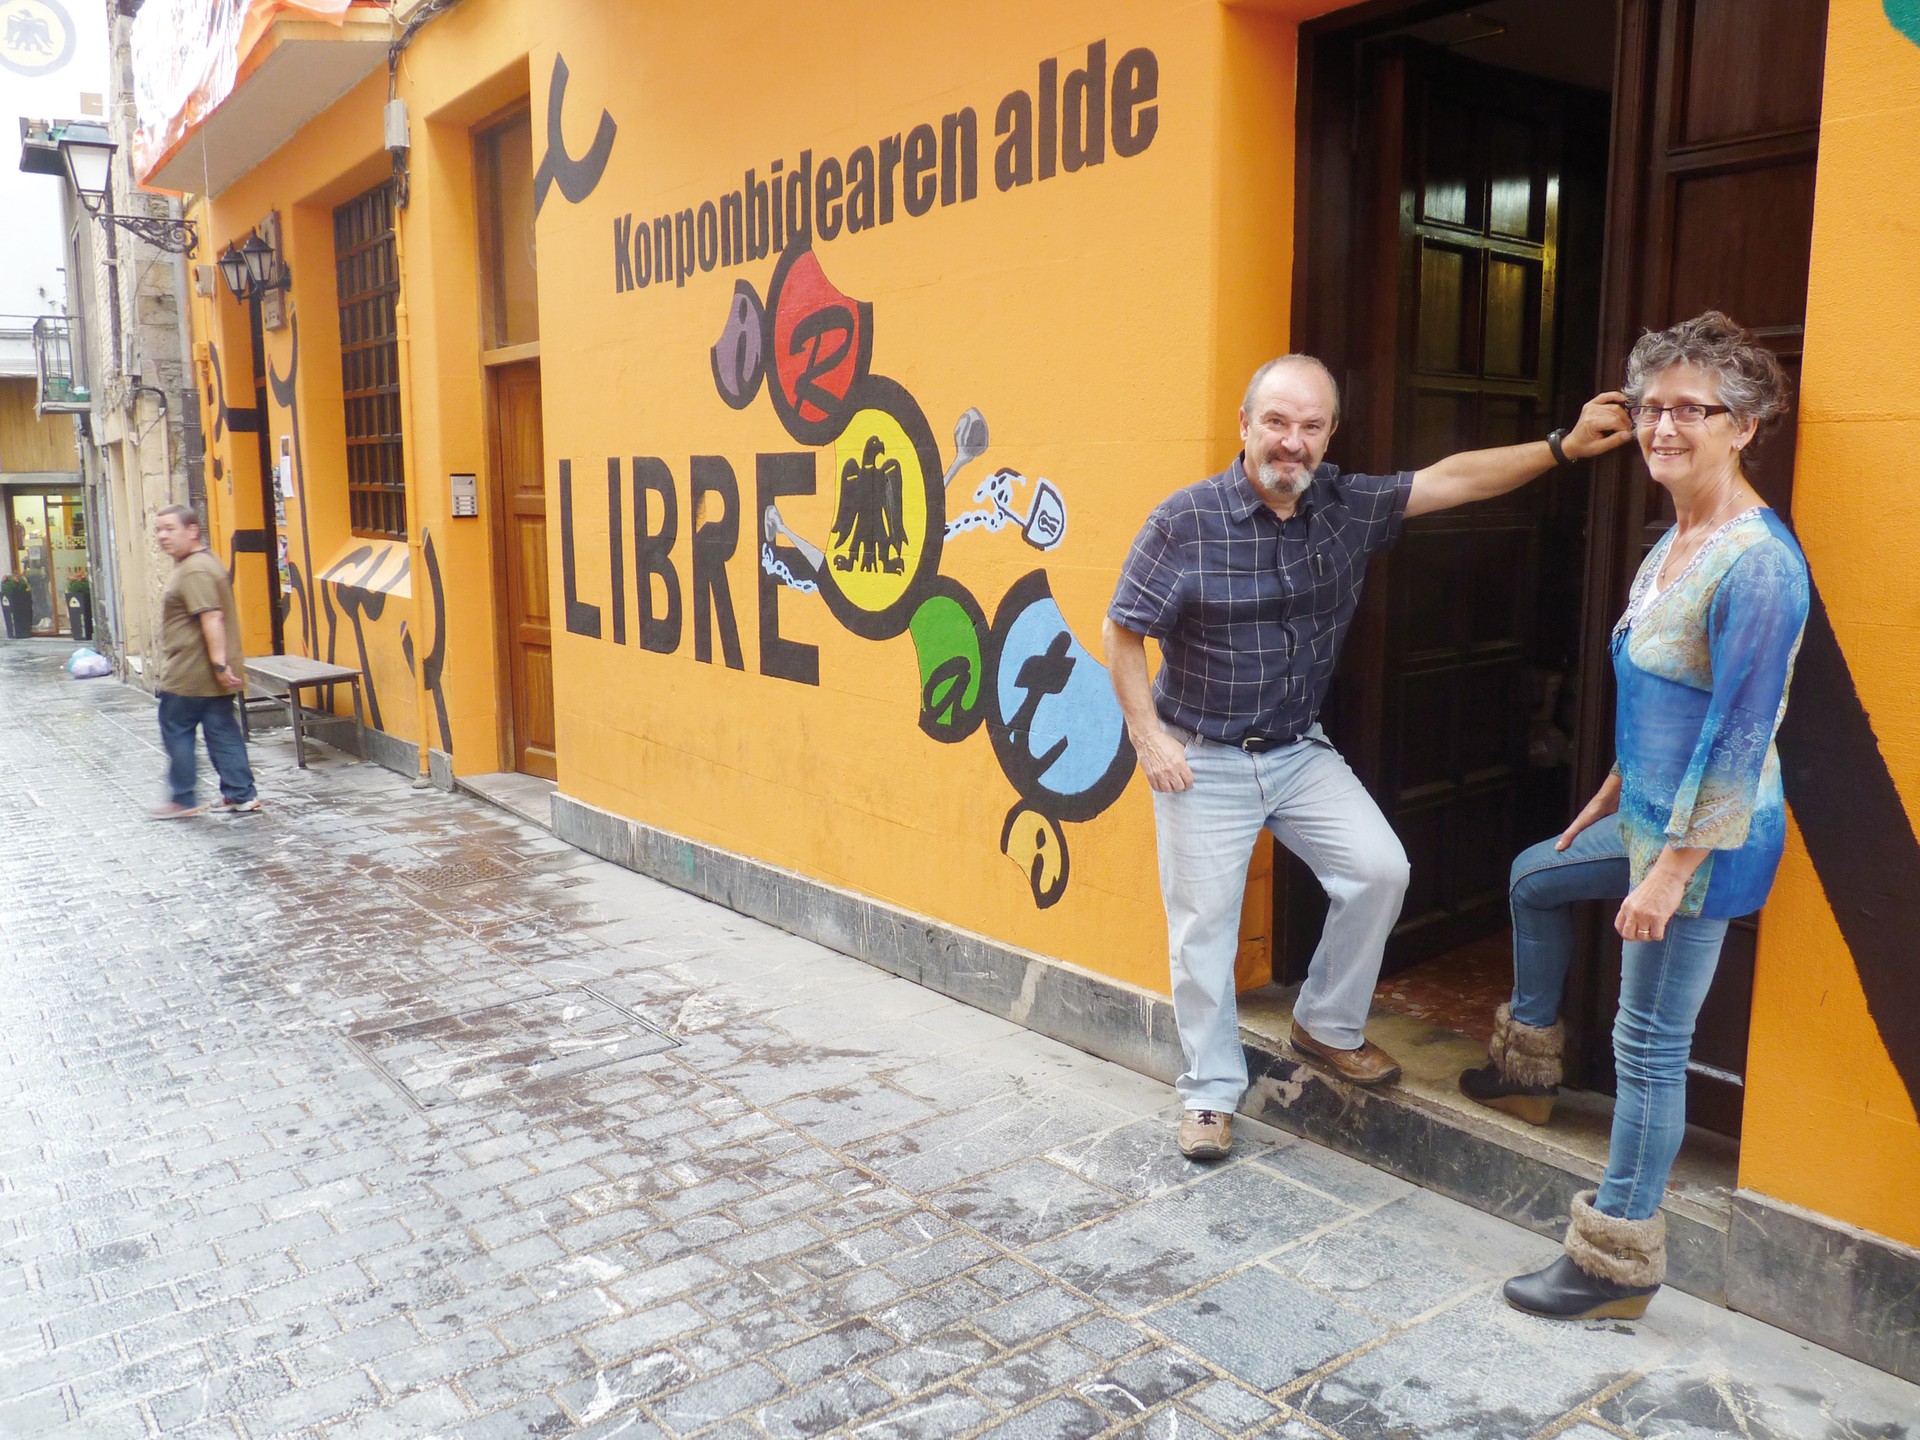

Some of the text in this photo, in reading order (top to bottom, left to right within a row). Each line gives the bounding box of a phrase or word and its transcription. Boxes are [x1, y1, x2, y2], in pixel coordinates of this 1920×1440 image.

[614, 38, 1159, 293] Konponbidearen alde
[558, 451, 820, 687] LIBRE
